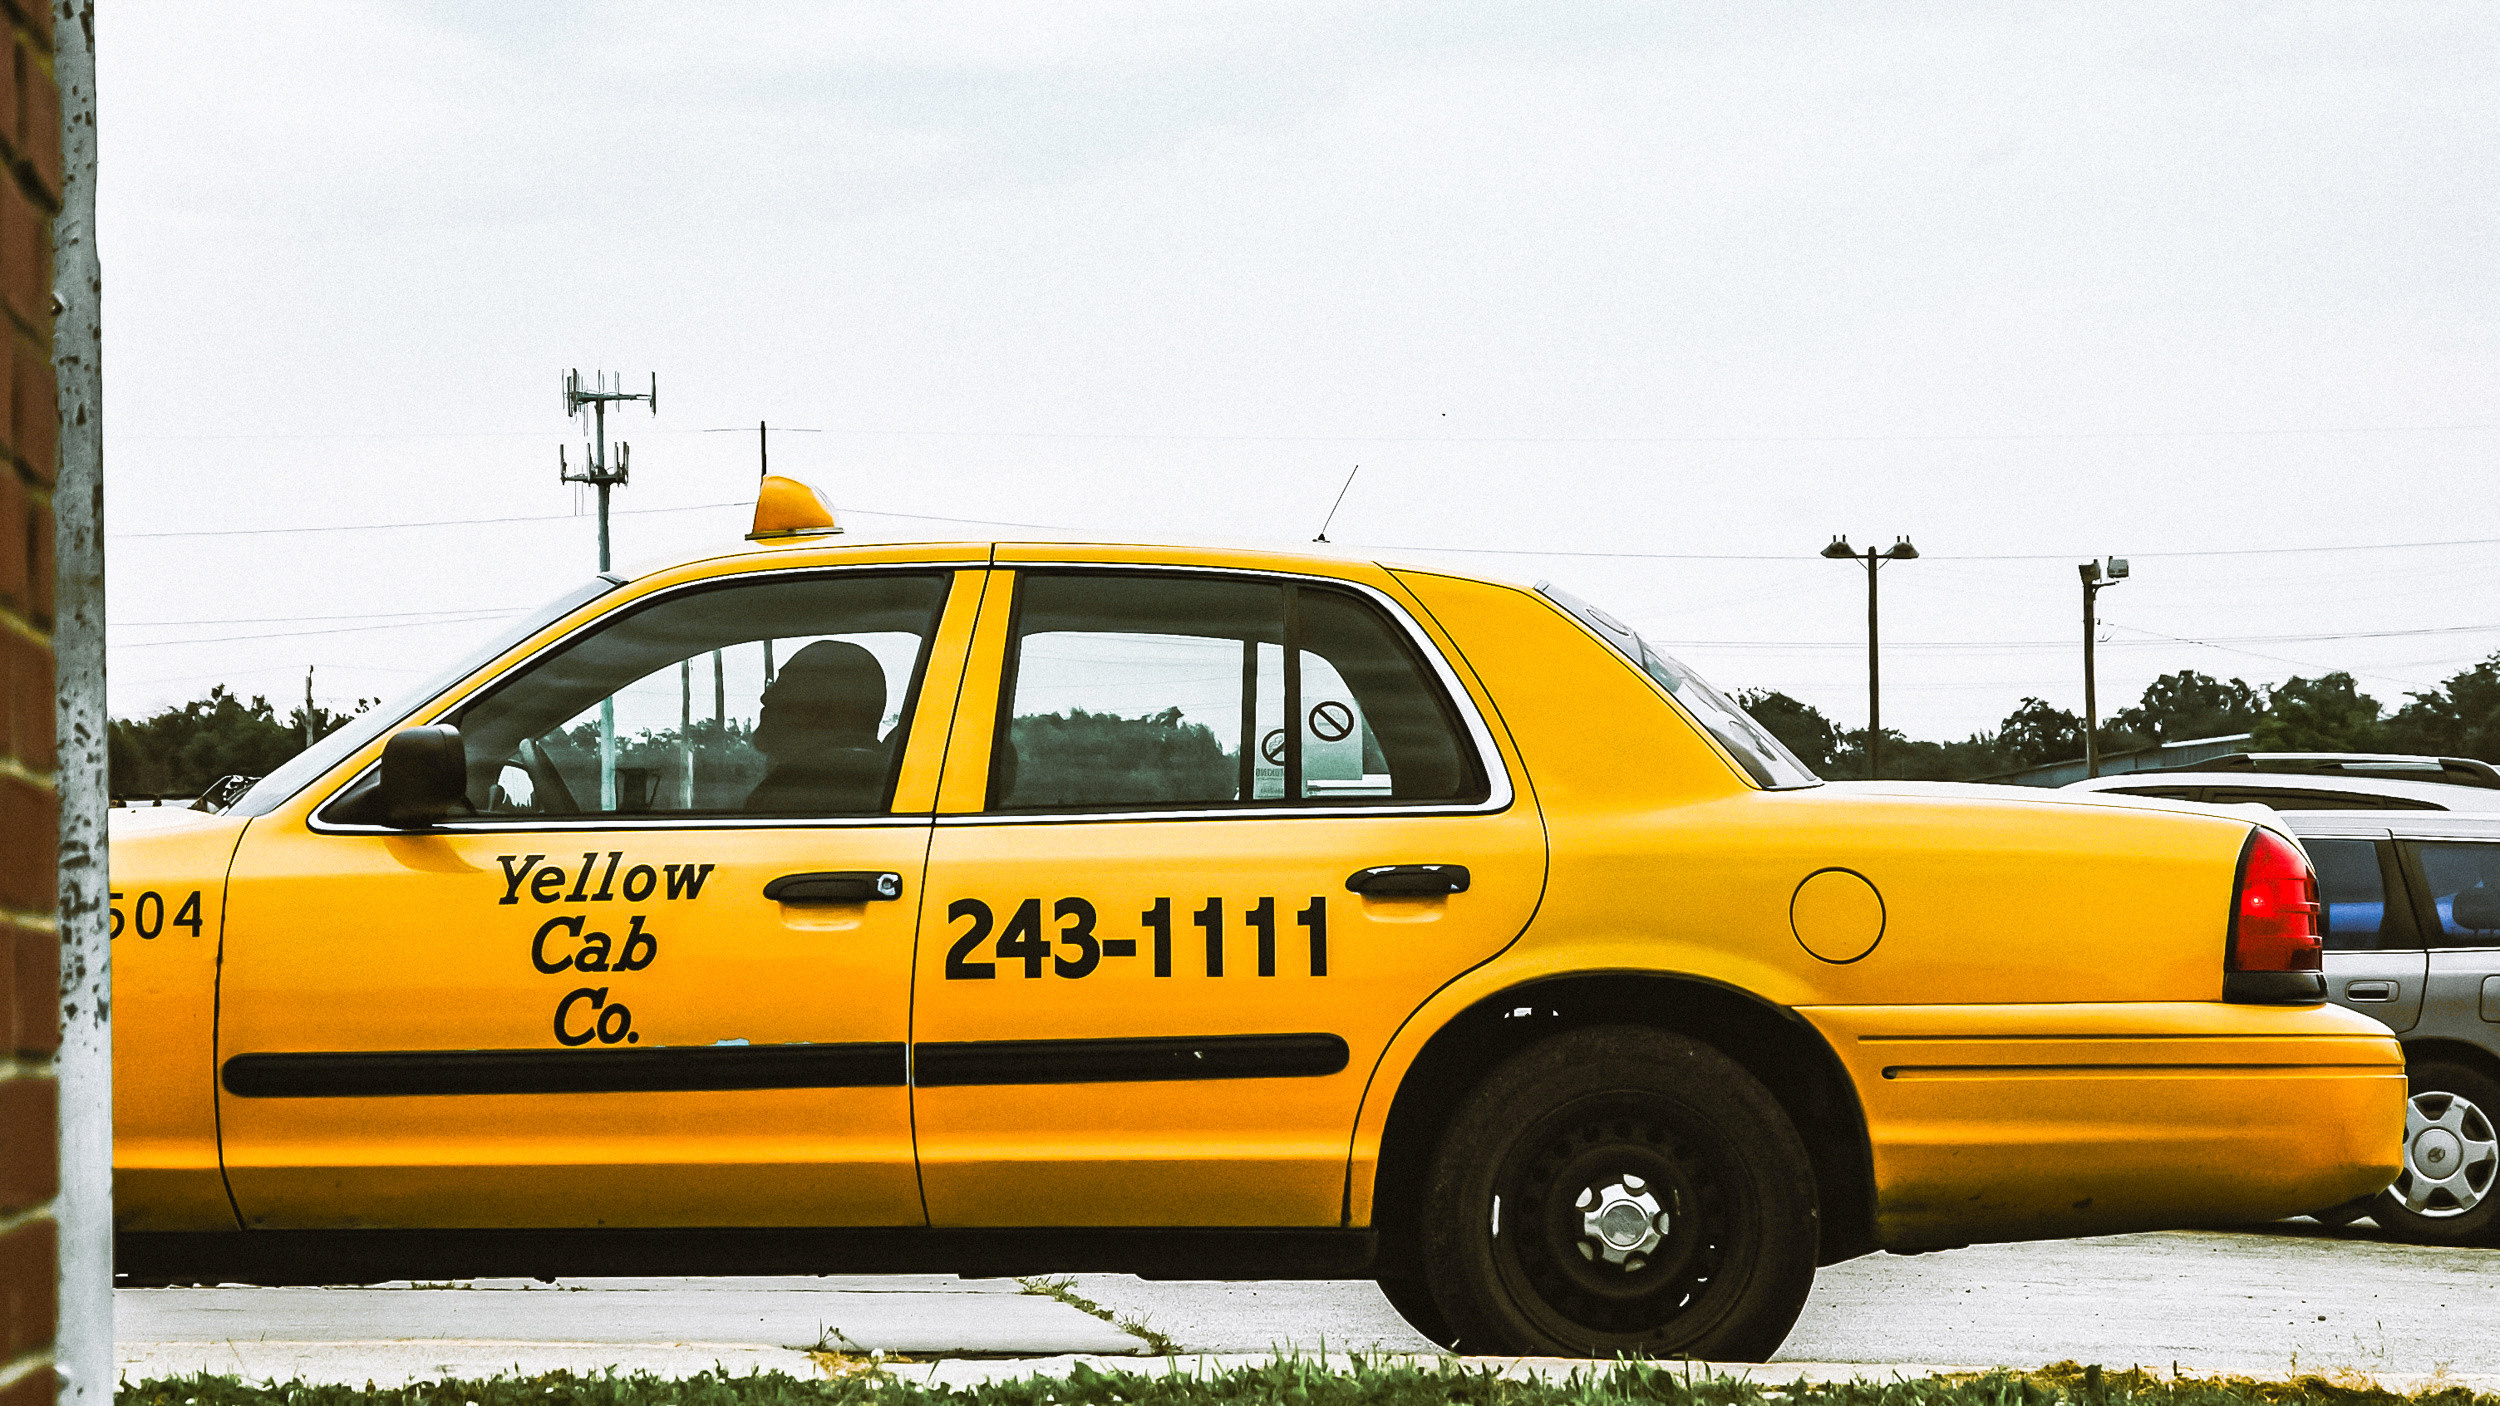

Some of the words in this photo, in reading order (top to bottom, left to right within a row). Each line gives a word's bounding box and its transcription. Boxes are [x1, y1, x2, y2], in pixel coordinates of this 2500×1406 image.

[497, 852, 715, 904] Yellow
[532, 916, 658, 974] Cab
[946, 897, 1328, 981] 243-1111
[553, 986, 639, 1046] Co.
